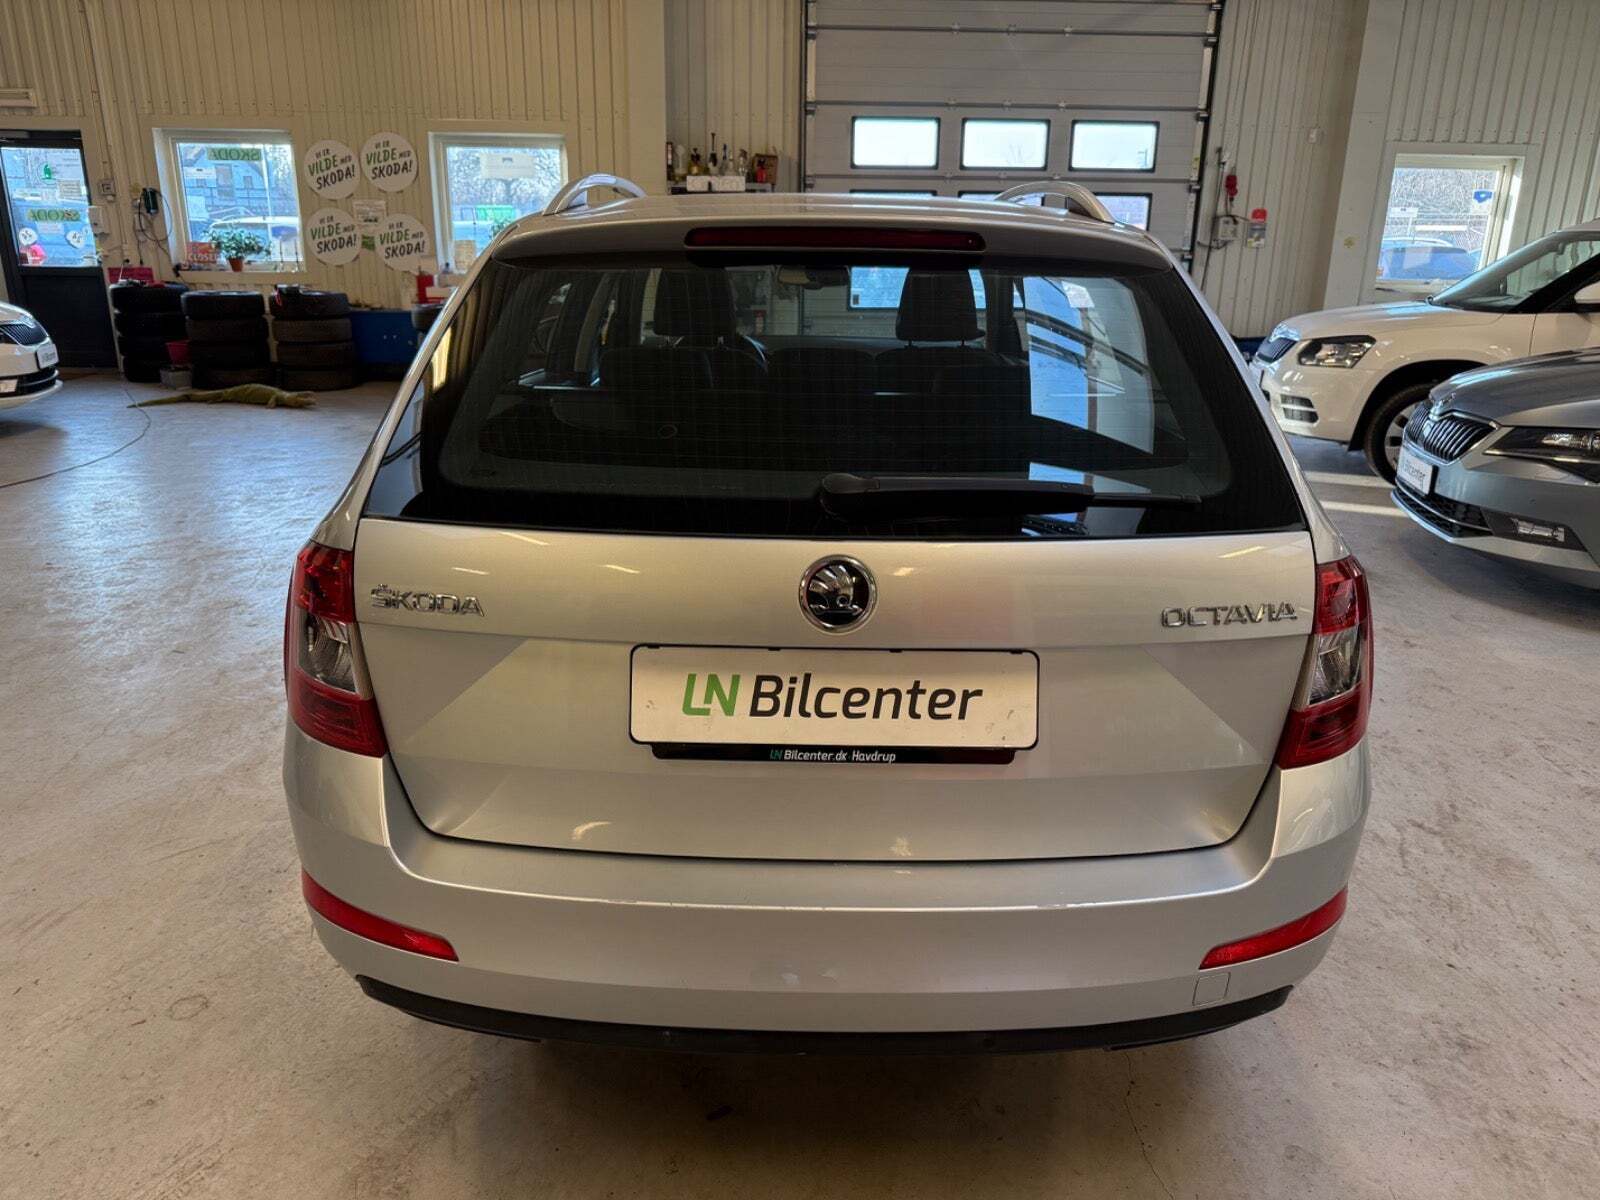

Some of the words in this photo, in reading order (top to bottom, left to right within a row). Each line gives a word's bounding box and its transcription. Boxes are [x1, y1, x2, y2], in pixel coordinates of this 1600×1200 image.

[308, 154, 338, 176] VILDE
[365, 147, 397, 166] VILDE
[316, 164, 355, 190] SKODA!
[371, 160, 412, 180] SKODA!
[310, 222, 341, 240] VILDE
[379, 228, 410, 245] VILDE
[317, 233, 357, 254] SKODA!
[384, 241, 425, 259] SKODA!
[1161, 602, 1298, 628] OCTAVIA
[682, 673, 741, 717] LN
[749, 673, 983, 720] Bilcenter
[852, 750, 896, 764] Havdrup
